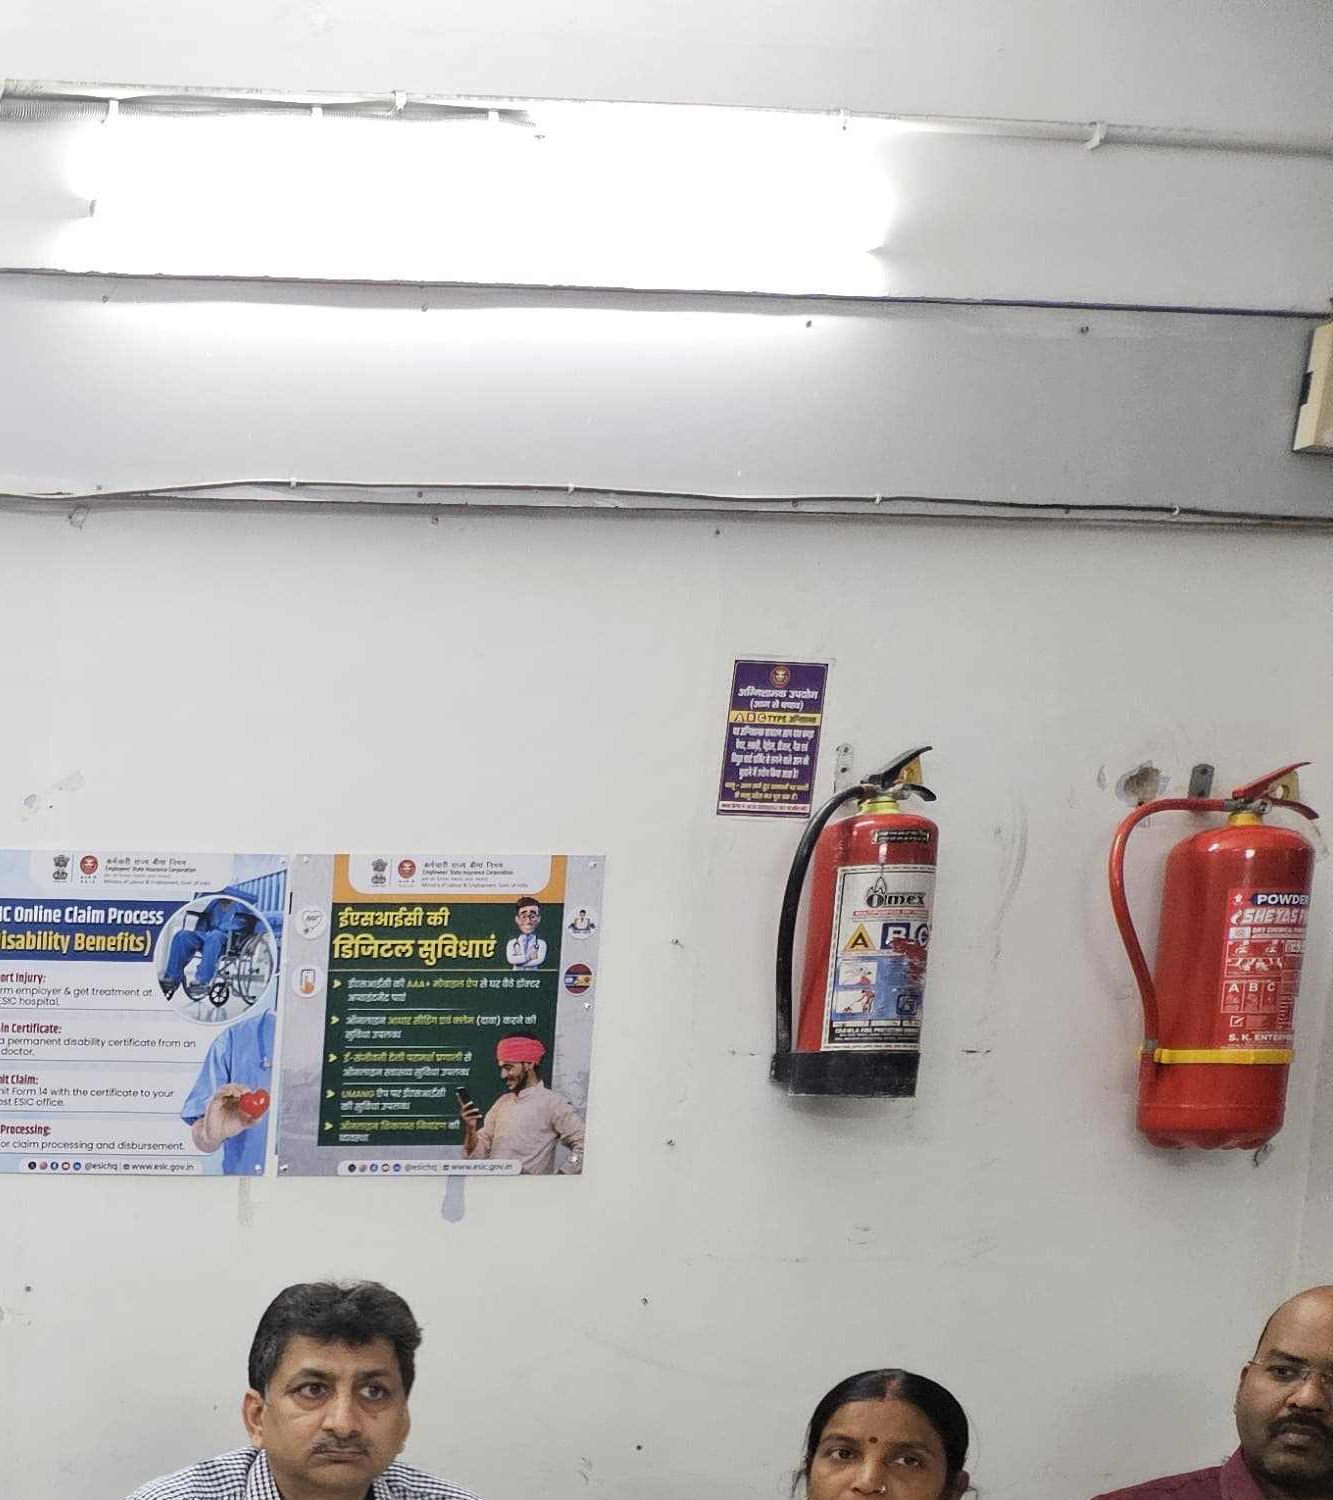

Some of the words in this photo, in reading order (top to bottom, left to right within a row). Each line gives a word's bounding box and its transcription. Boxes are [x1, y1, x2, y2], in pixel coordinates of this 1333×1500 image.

[14, 906, 61, 923] Online
[64, 907, 104, 925] Claim
[107, 908, 164, 925] Process
[338, 906, 423, 929] ईएसआईसी
[427, 907, 450, 927] की
[74, 930, 152, 956] Benefits)
[333, 932, 415, 960] डिजिटल
[417, 933, 497, 966] सुविधाएं
[15, 972, 46, 985] Injury:
[15, 986, 62, 997] employer
[63, 987, 71, 995] &
[73, 988, 89, 998] get
[91, 988, 139, 997] treatment
[142, 989, 152, 997] at
[1229, 983, 1240, 993] A
[1249, 983, 1258, 992] B
[1267, 983, 1276, 992] C
[11, 1023, 62, 1034] Certificate:
[7, 1038, 61, 1048] permanent
[63, 1038, 106, 1049] disability
[108, 1038, 156, 1048] certificate
[158, 1039, 181, 1048] from
[11, 1074, 39, 1086] Claim:
[12, 1087, 37, 1096] Form
[39, 1087, 48, 1096] 14
[50, 1087, 70, 1096] with
[72, 1088, 88, 1096] the
[90, 1088, 139, 1098] certificate
[140, 1089, 151, 1098] to
[153, 1090, 174, 1100] your
[14, 1098, 34, 1107] ESIC
[0, 1124, 51, 1136] Processing:
[12, 1140, 39, 1149] claim
[41, 1141, 93, 1152] processing
[96, 1142, 115, 1150] and
